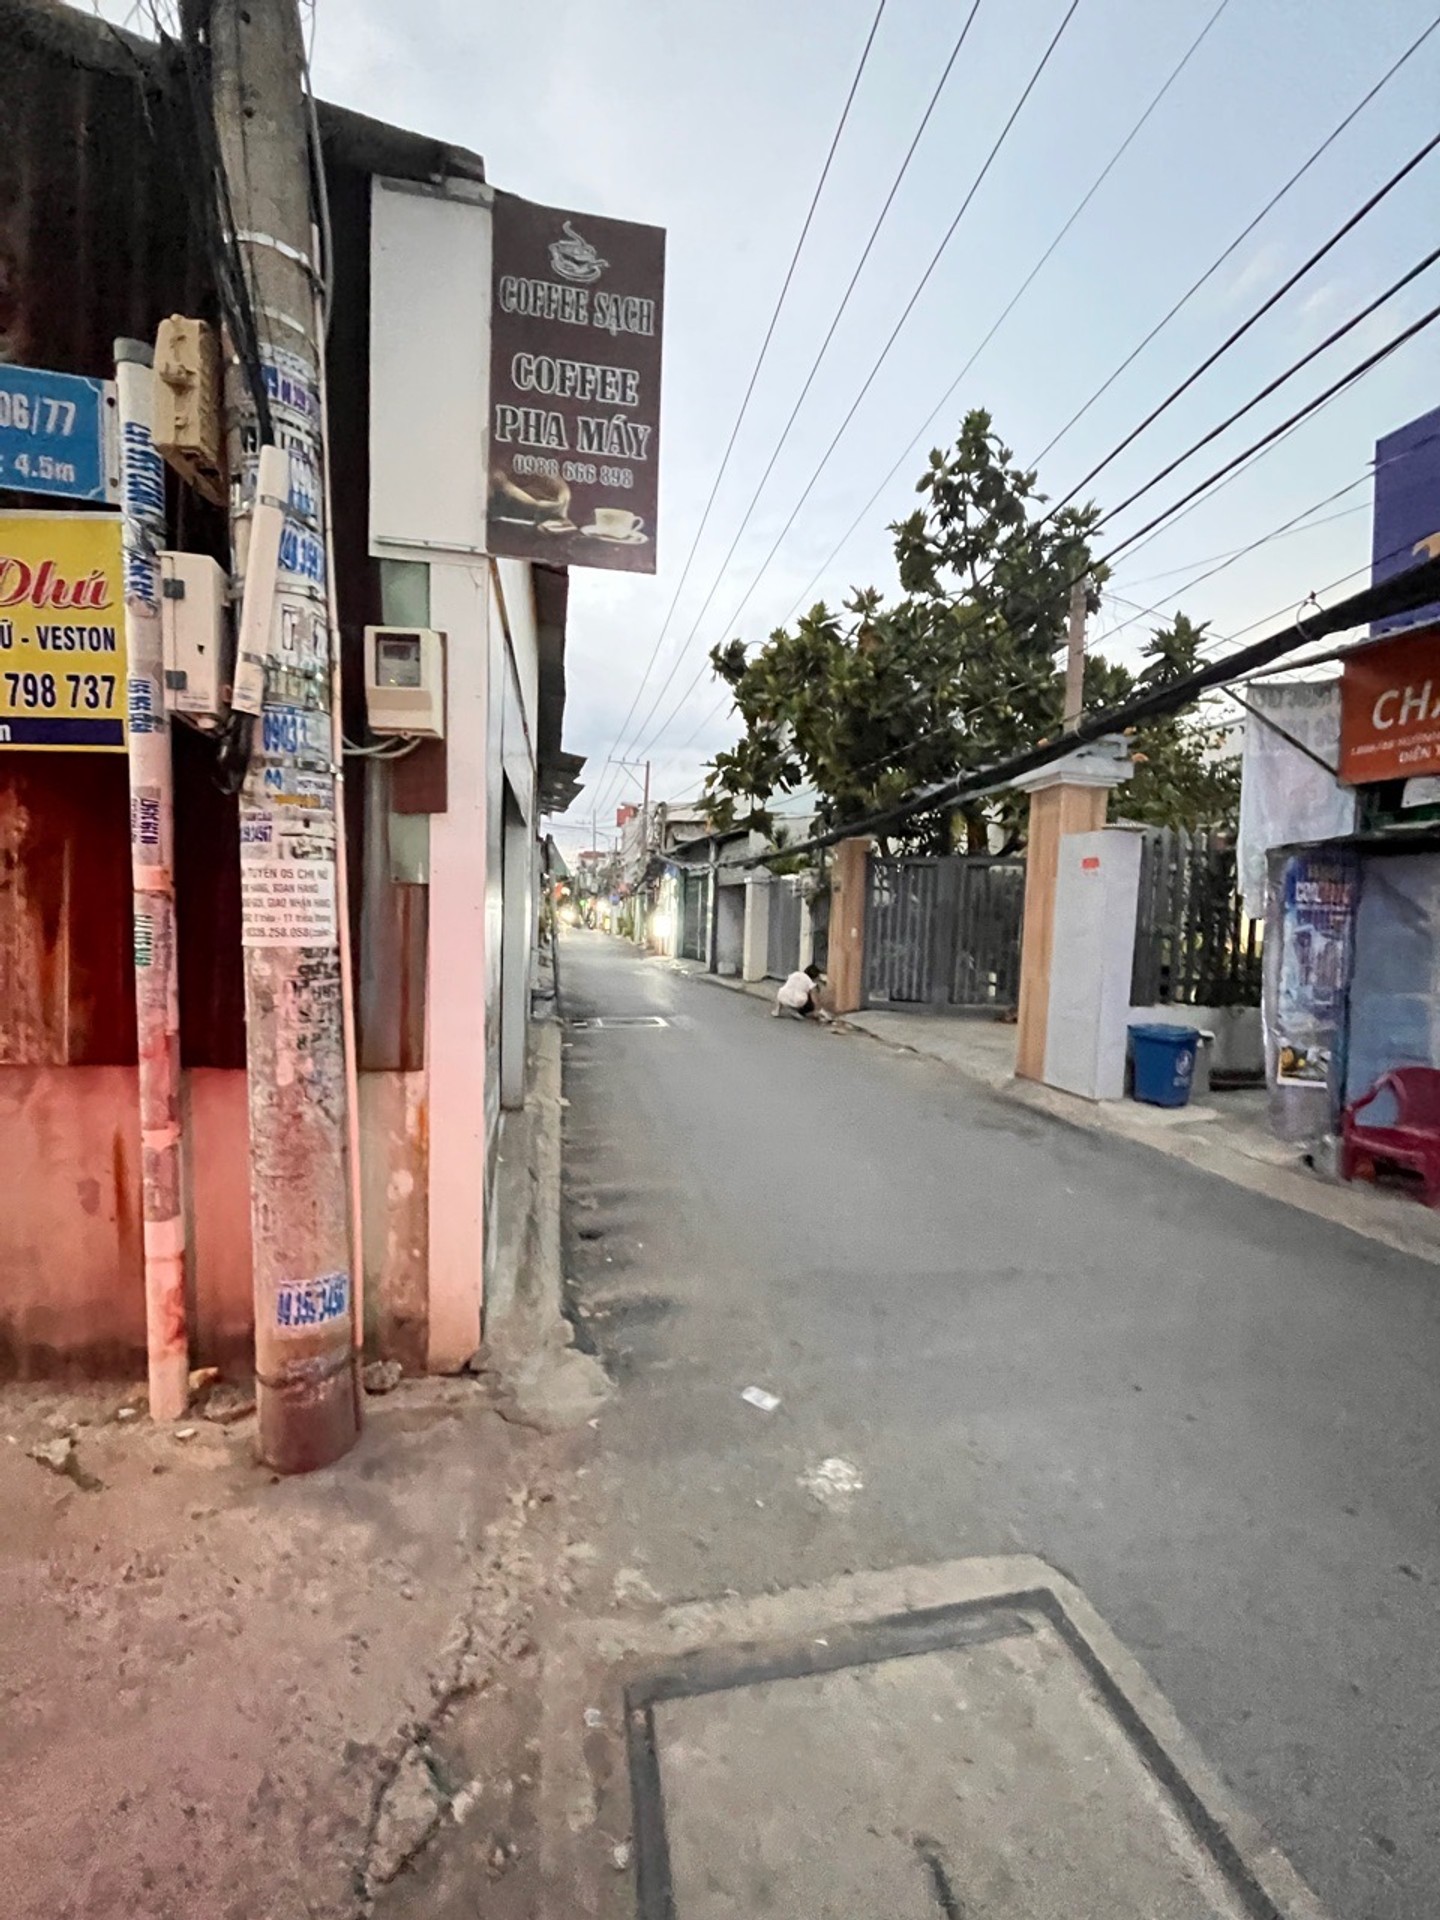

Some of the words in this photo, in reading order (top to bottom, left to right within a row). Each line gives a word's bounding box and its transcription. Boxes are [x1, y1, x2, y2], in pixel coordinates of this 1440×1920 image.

[500, 275, 589, 326] COFFEE
[593, 291, 655, 336] SẠCH
[512, 352, 640, 407] COFFEE
[494, 404, 569, 450] PHA
[576, 414, 651, 461] MÁY
[14, 453, 75, 483] 4.5m
[36, 625, 116, 652] VESTON
[4, 672, 57, 709] 798
[65, 674, 116, 710] 737
